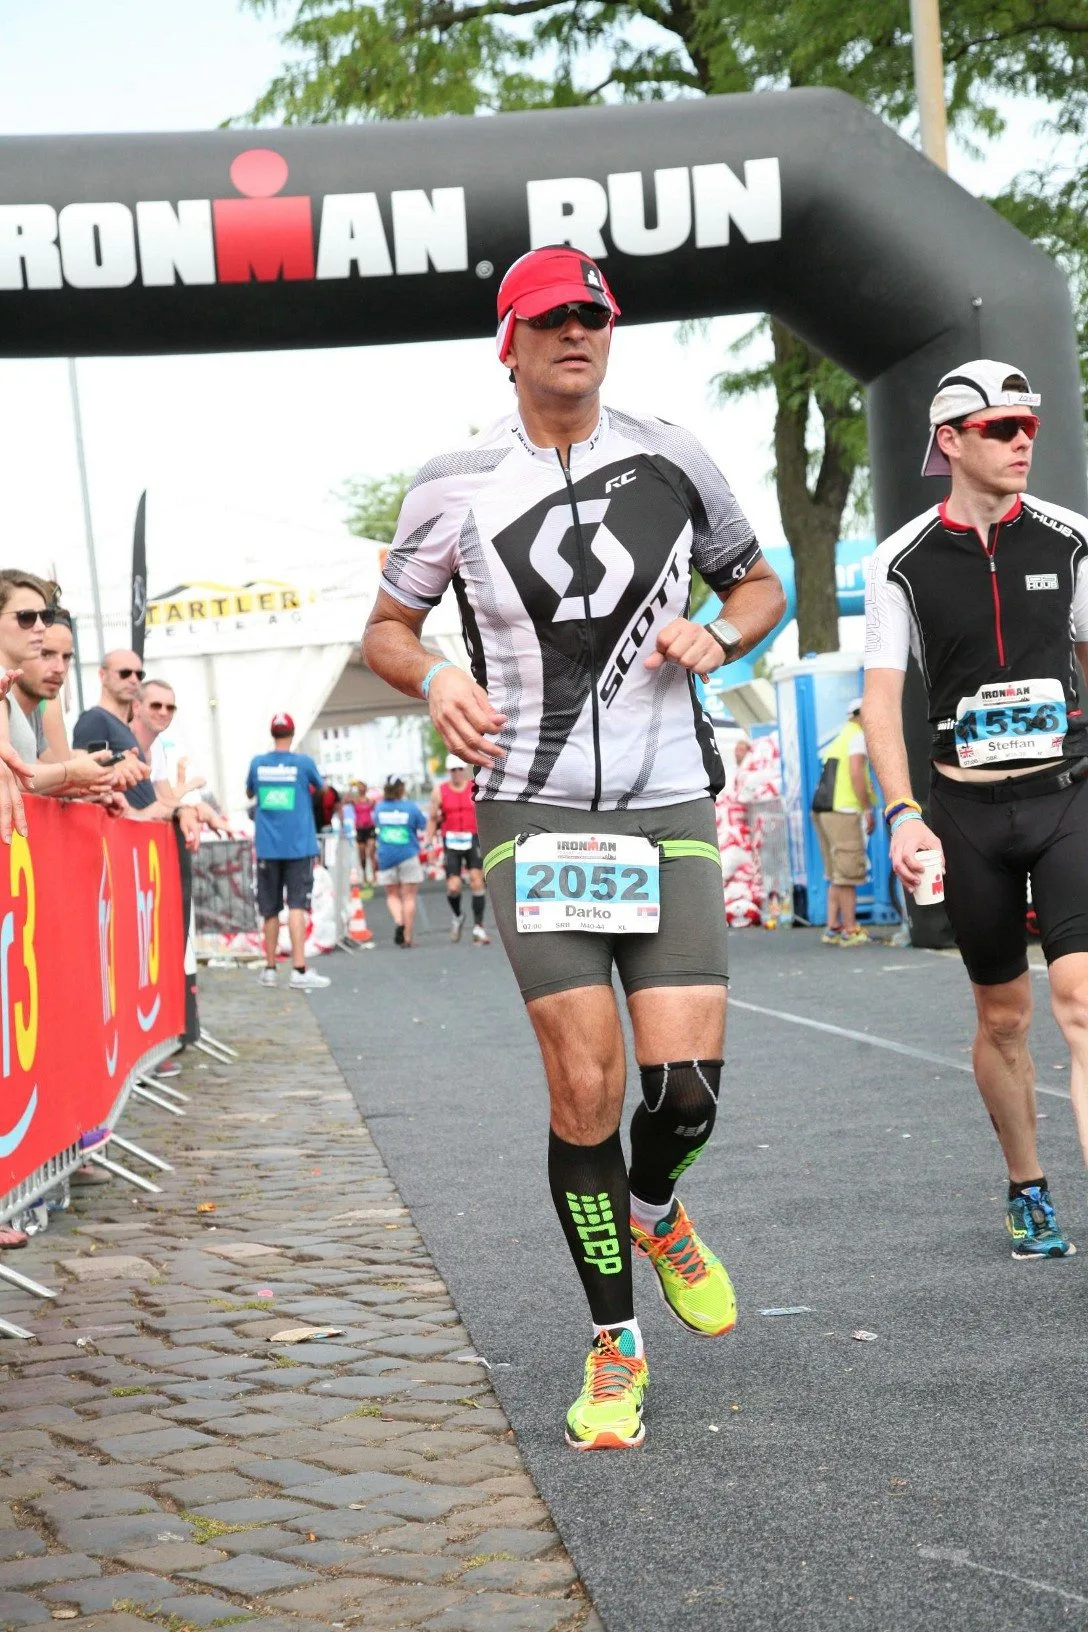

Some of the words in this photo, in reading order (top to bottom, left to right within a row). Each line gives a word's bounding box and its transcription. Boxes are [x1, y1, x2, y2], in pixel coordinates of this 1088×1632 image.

[526, 157, 781, 259] RUN
[1032, 511, 1074, 538] HUUB
[600, 551, 680, 710] SCOTT
[982, 685, 1031, 700] IRONMAN
[957, 704, 1061, 741] 1556
[988, 740, 1035, 752] Steffan
[557, 837, 616, 851] IRONMAN
[526, 864, 650, 900] 2052
[565, 905, 612, 919] Darko
